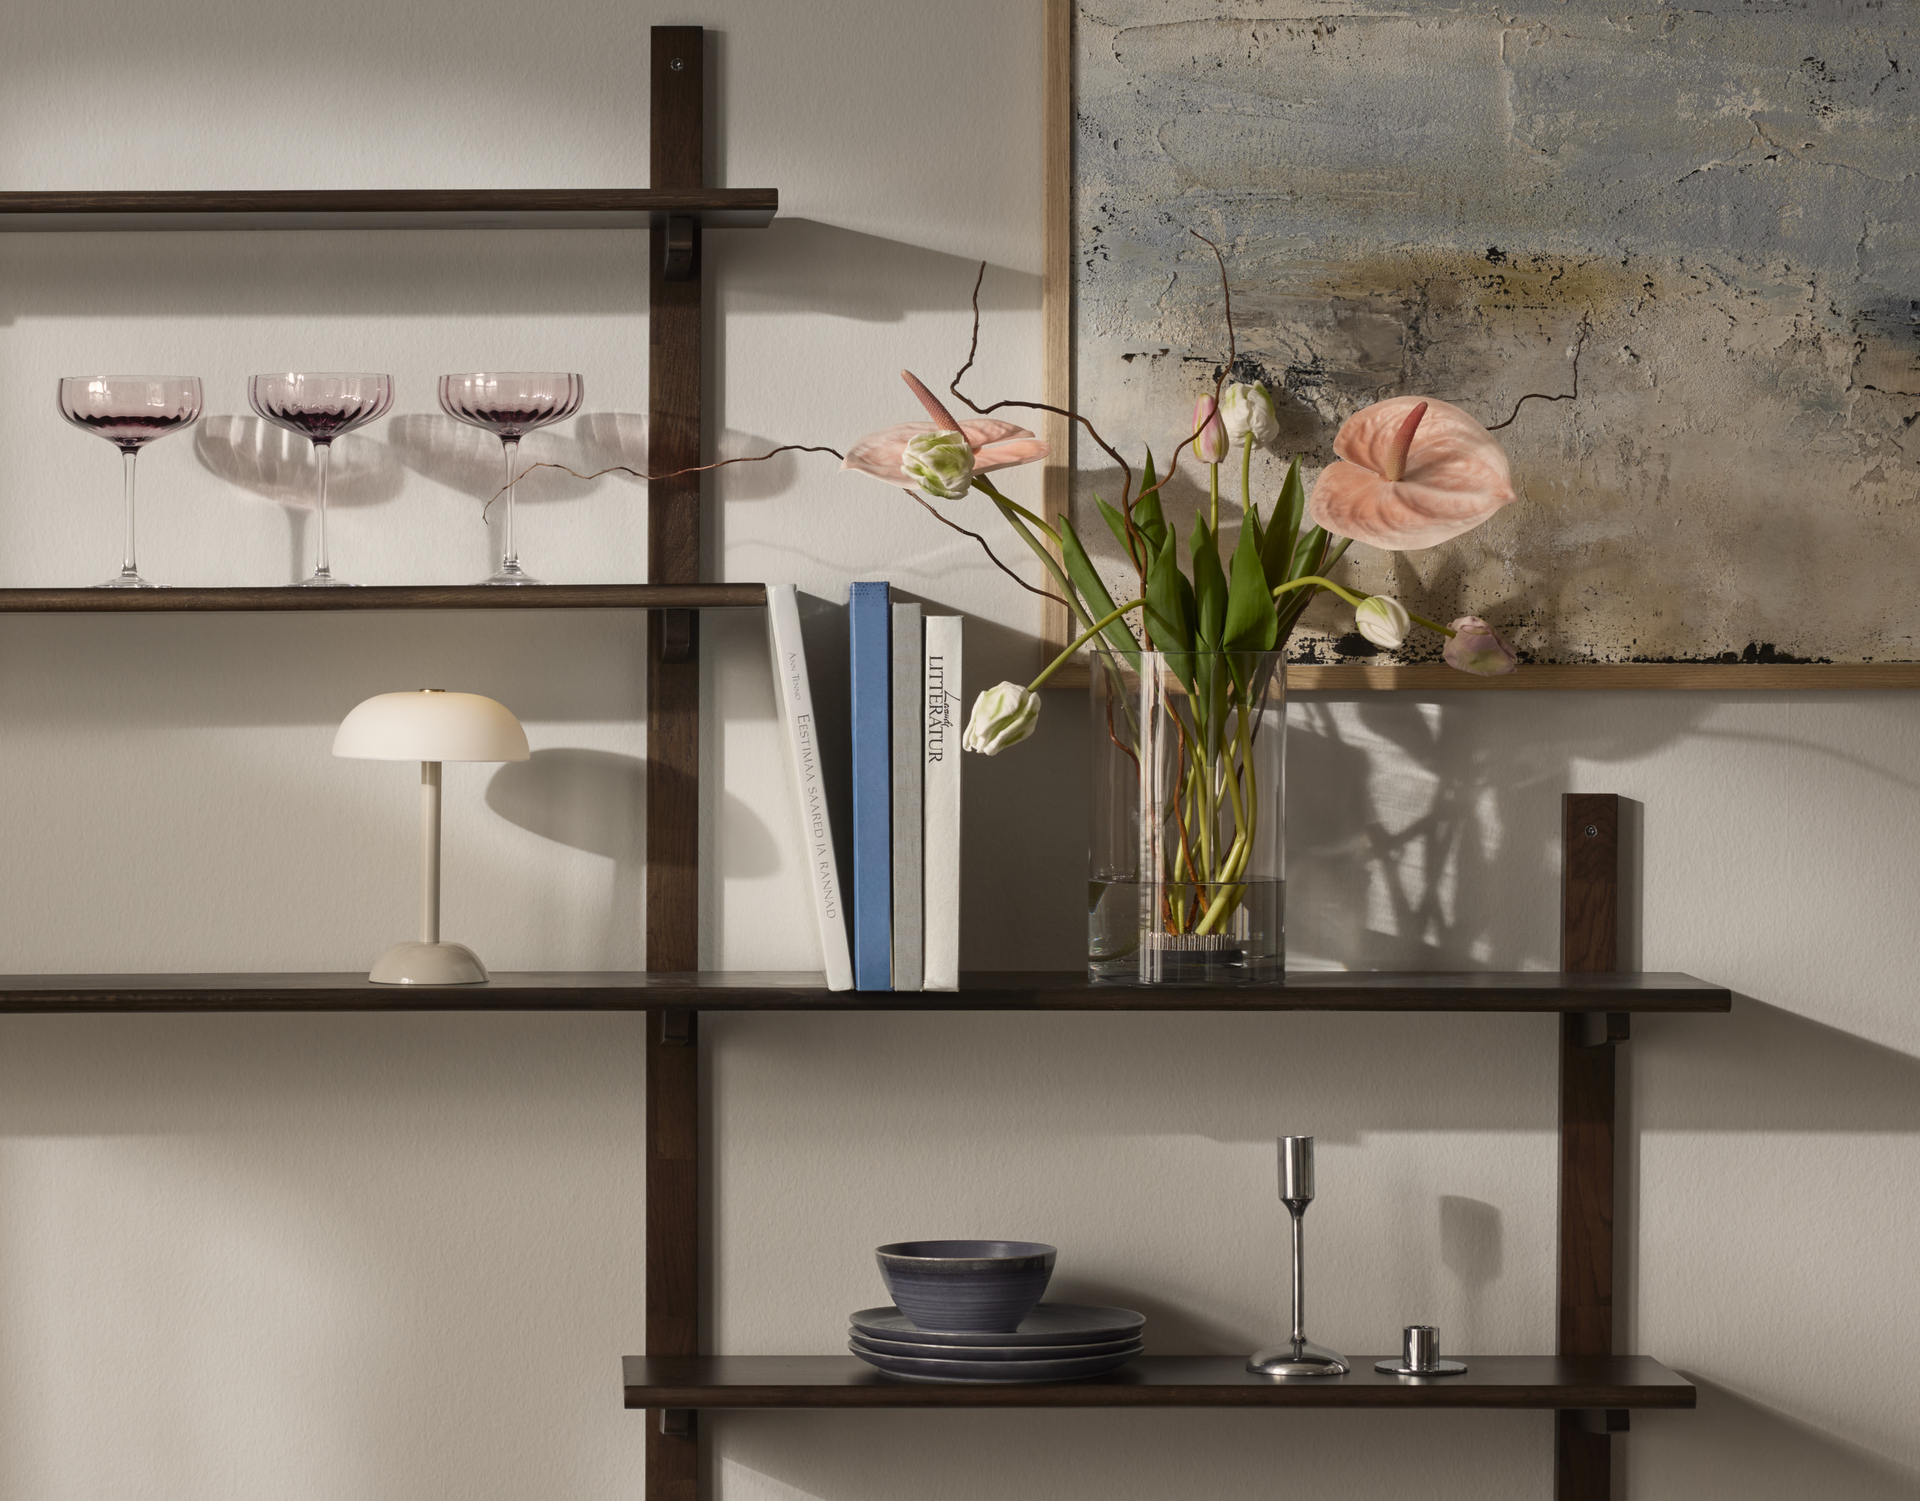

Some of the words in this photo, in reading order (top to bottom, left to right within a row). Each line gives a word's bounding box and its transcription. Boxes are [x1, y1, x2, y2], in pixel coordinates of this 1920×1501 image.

[929, 655, 943, 763] LITTERATUR
[798, 714, 815, 782] EESTIMAA
[807, 786, 824, 839] SAARED
[819, 861, 836, 919] RANNAD
